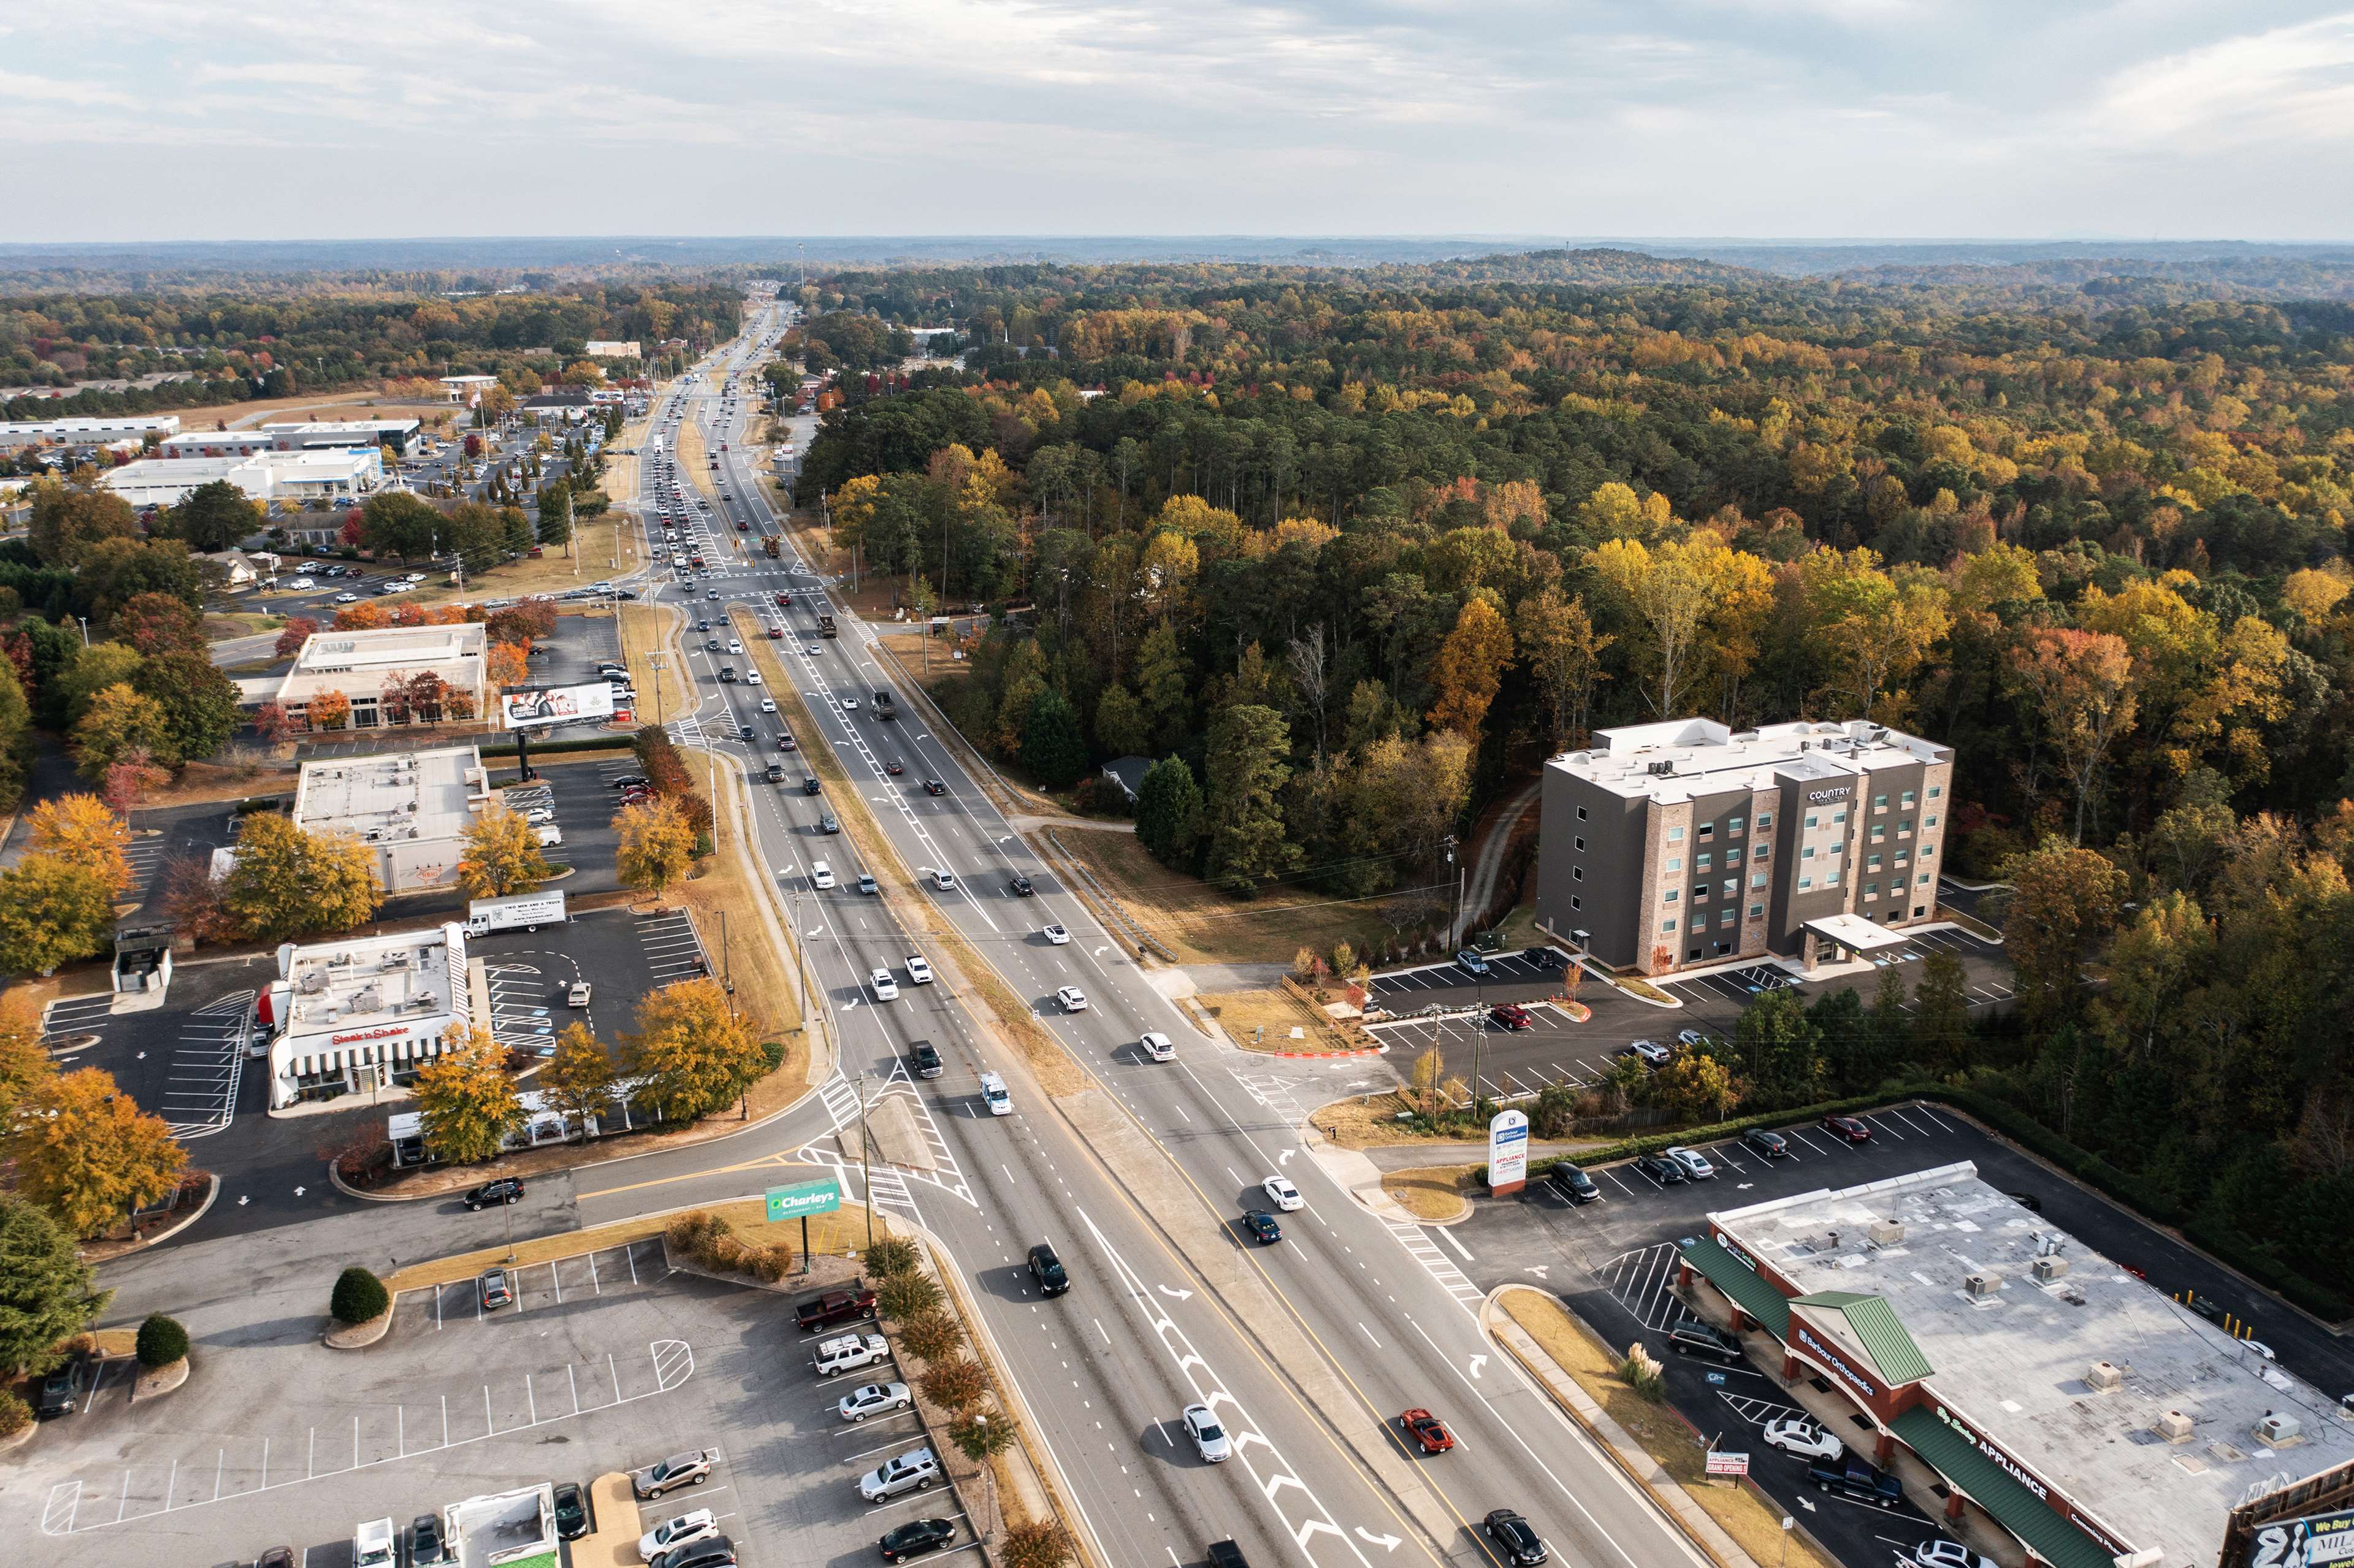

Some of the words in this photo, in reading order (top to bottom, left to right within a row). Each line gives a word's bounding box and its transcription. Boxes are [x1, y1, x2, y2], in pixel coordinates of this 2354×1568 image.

[1809, 787, 1851, 800] COUNTRY
[373, 1028, 409, 1039] Shake
[1496, 1153, 1525, 1164] APPLIANCE
[771, 1192, 835, 1210] O'Charley's
[1807, 1337, 1832, 1361] Barbour
[1832, 1357, 1873, 1396] Orthopaedics
[1979, 1441, 2047, 1501] APPLIANCE
[2071, 1513, 2103, 1543] Cumming
[2316, 1522, 2331, 1532] We
[2332, 1519, 2351, 1529] Buy
